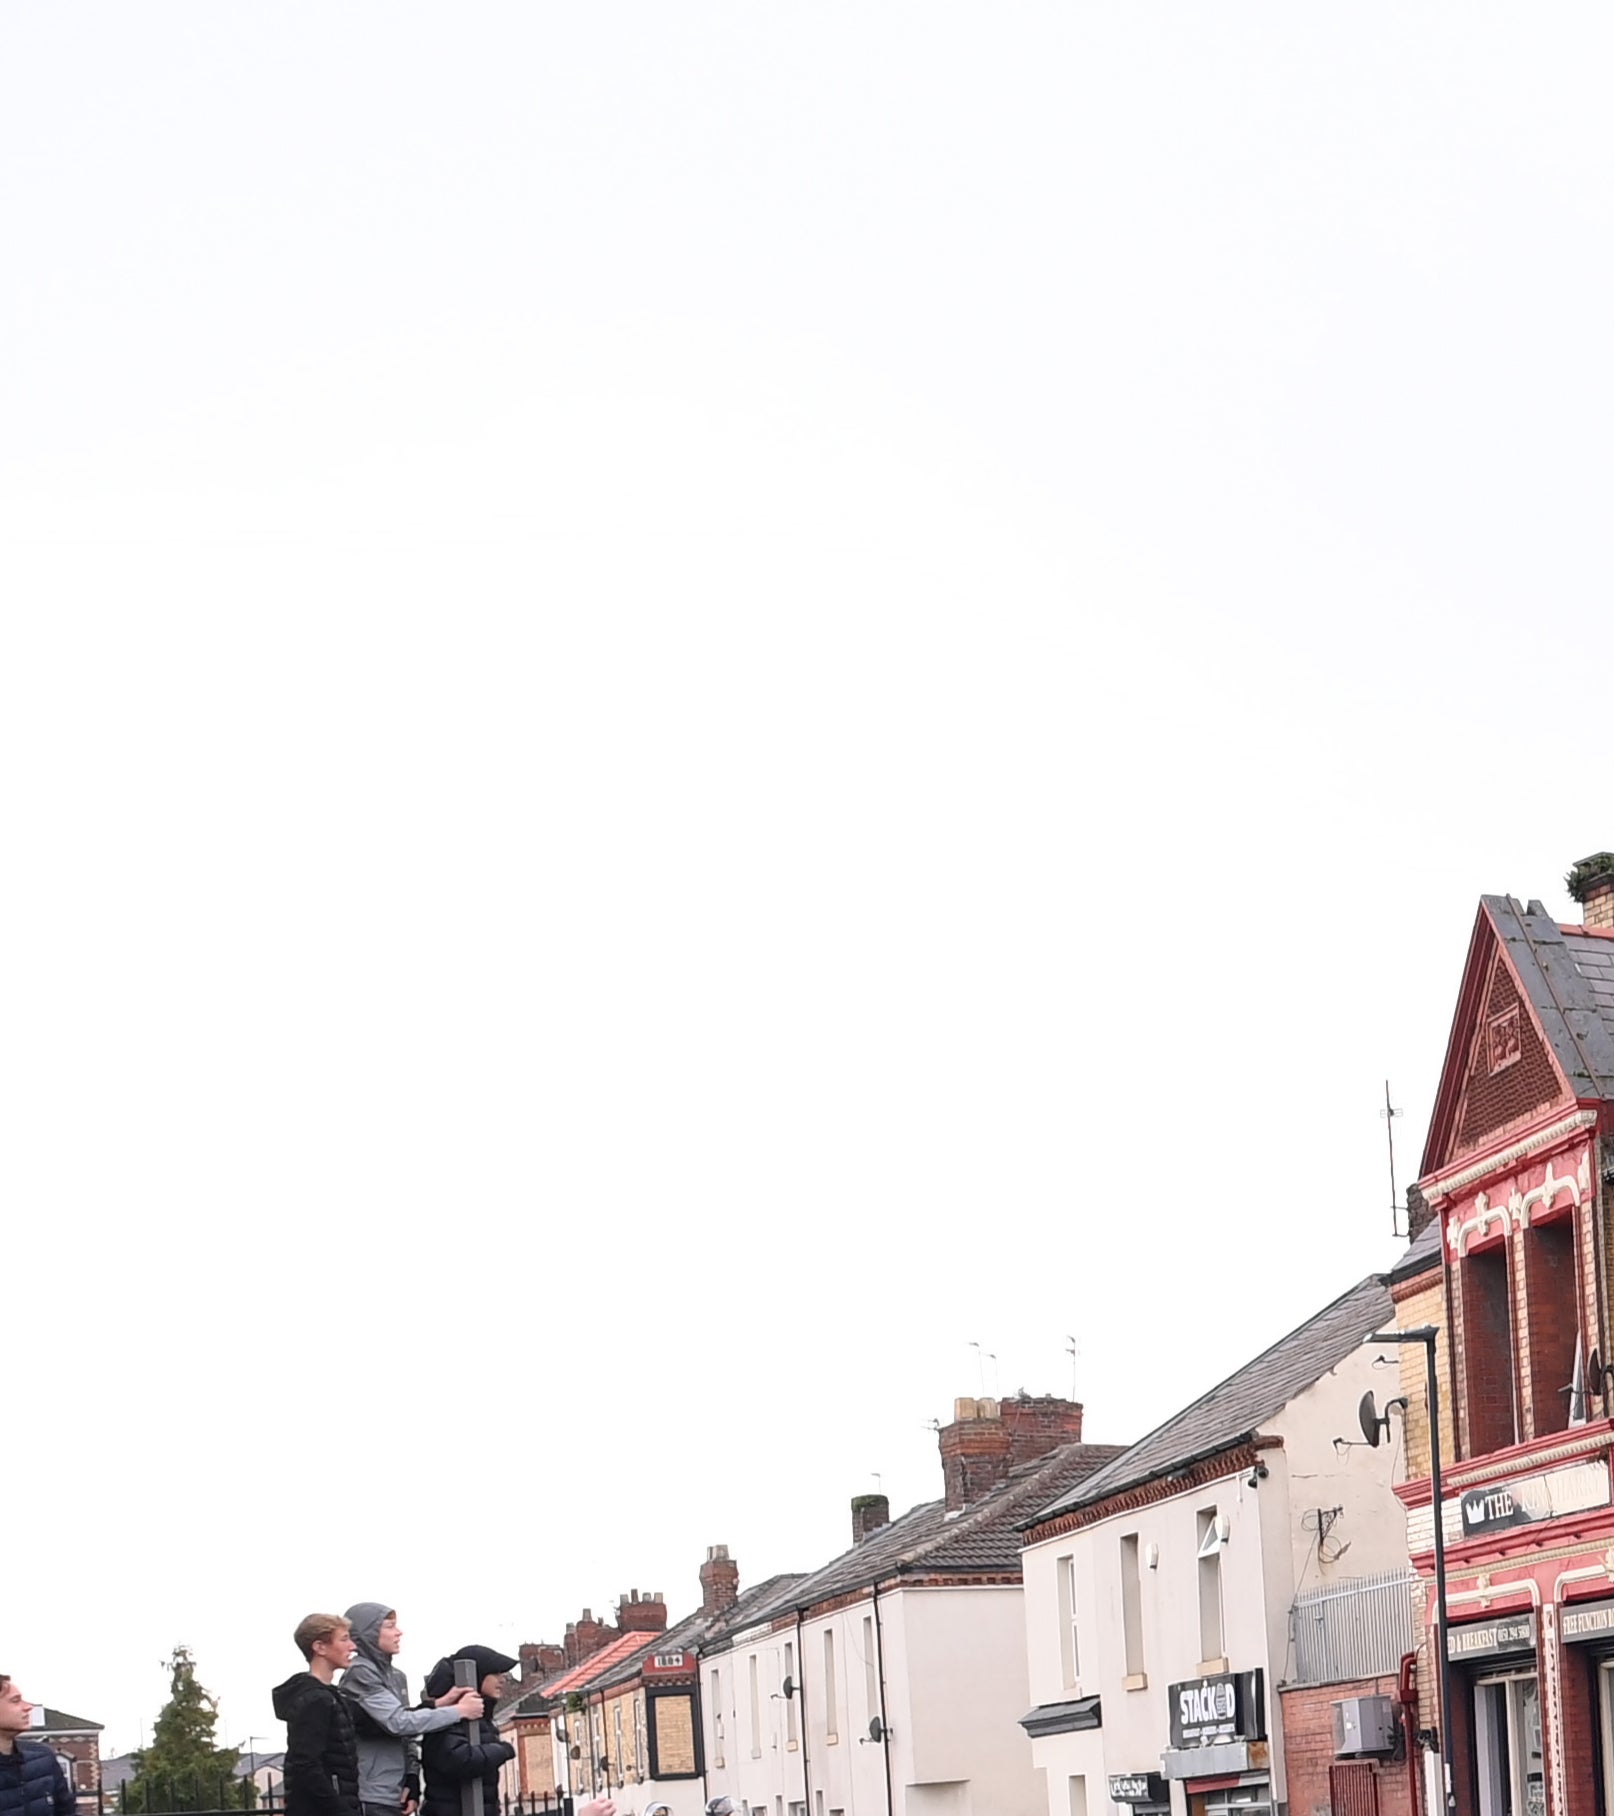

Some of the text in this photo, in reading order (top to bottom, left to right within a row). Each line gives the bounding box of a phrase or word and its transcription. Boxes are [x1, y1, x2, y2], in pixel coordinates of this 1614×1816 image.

[1485, 1491, 1513, 1520] THE
[1563, 1614, 1578, 1635] FREE
[1578, 1609, 1607, 1633] FUNCTION
[1462, 1627, 1497, 1651] BREAKFAST
